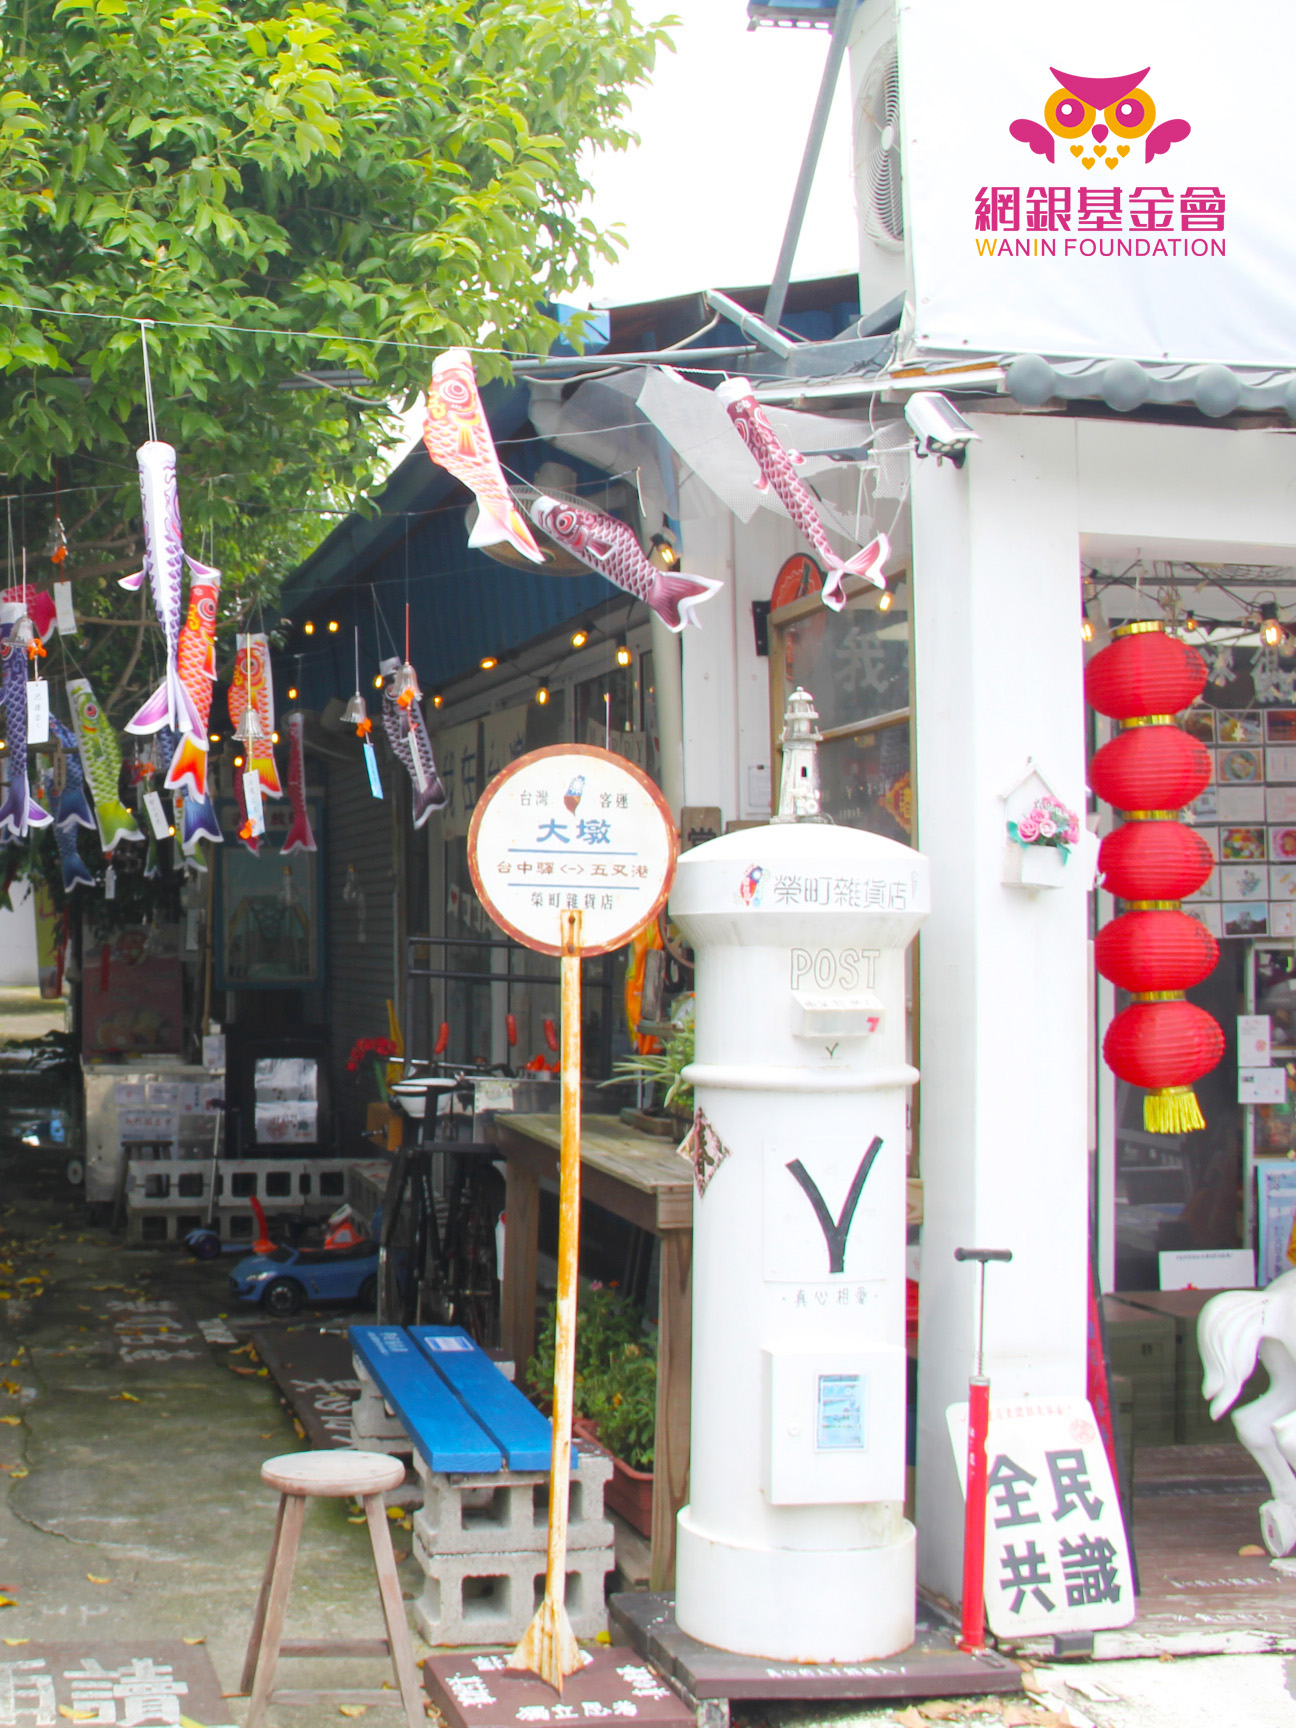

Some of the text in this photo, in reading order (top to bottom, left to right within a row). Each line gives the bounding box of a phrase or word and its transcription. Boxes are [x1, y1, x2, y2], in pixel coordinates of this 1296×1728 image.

[520, 789, 629, 809] 台灣 客運
[536, 818, 611, 845] 大墩
[530, 891, 614, 911] 榮町雜貨店
[773, 874, 908, 911] 榮町雜貨店
[790, 947, 882, 991] POST
[999, 1533, 1122, 1615] 共識
